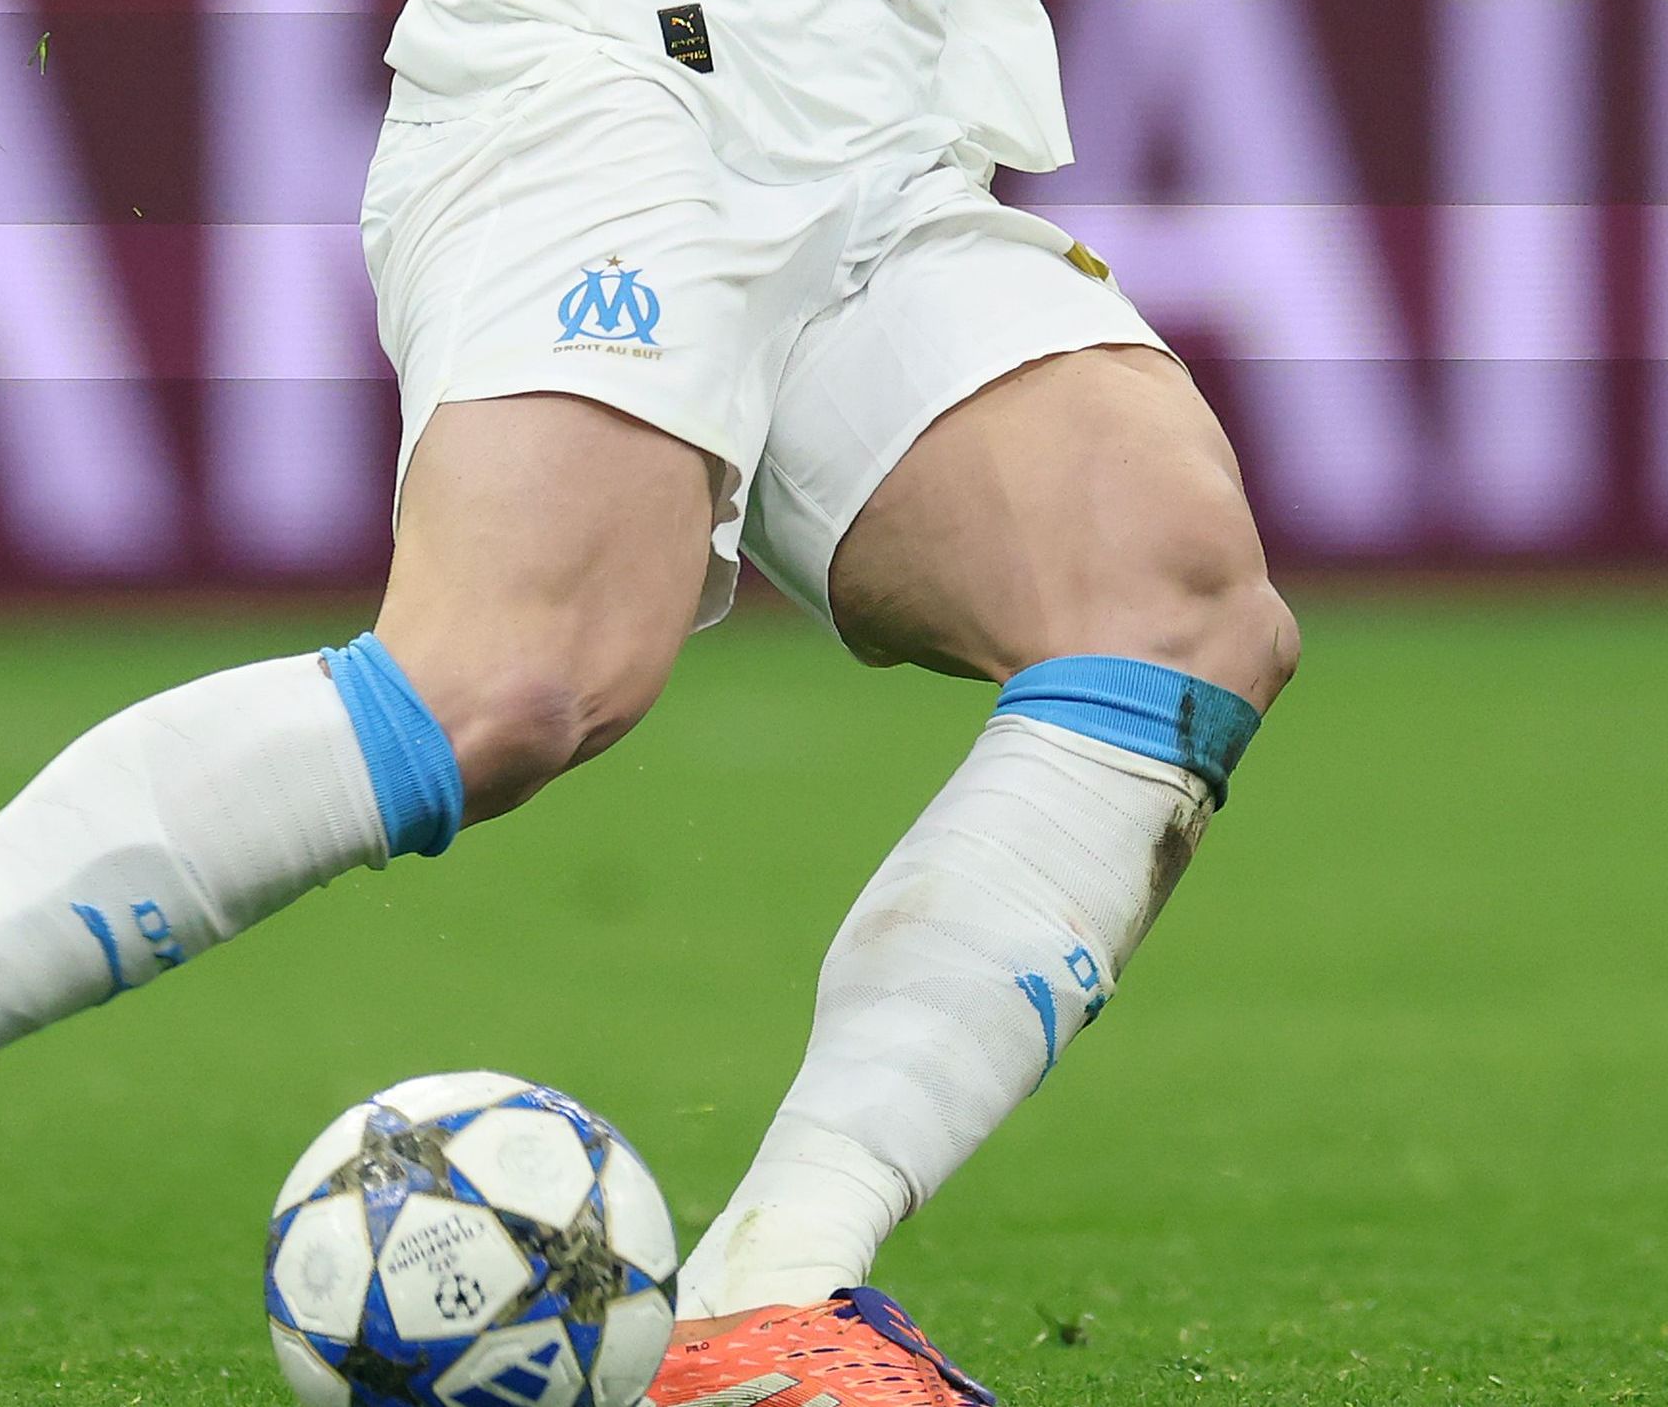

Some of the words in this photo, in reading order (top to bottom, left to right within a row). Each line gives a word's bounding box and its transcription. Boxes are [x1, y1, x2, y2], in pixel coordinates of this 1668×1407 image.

[552, 344, 601, 353] DROIT
[605, 345, 627, 355] AU
[632, 349, 663, 360] BUT
